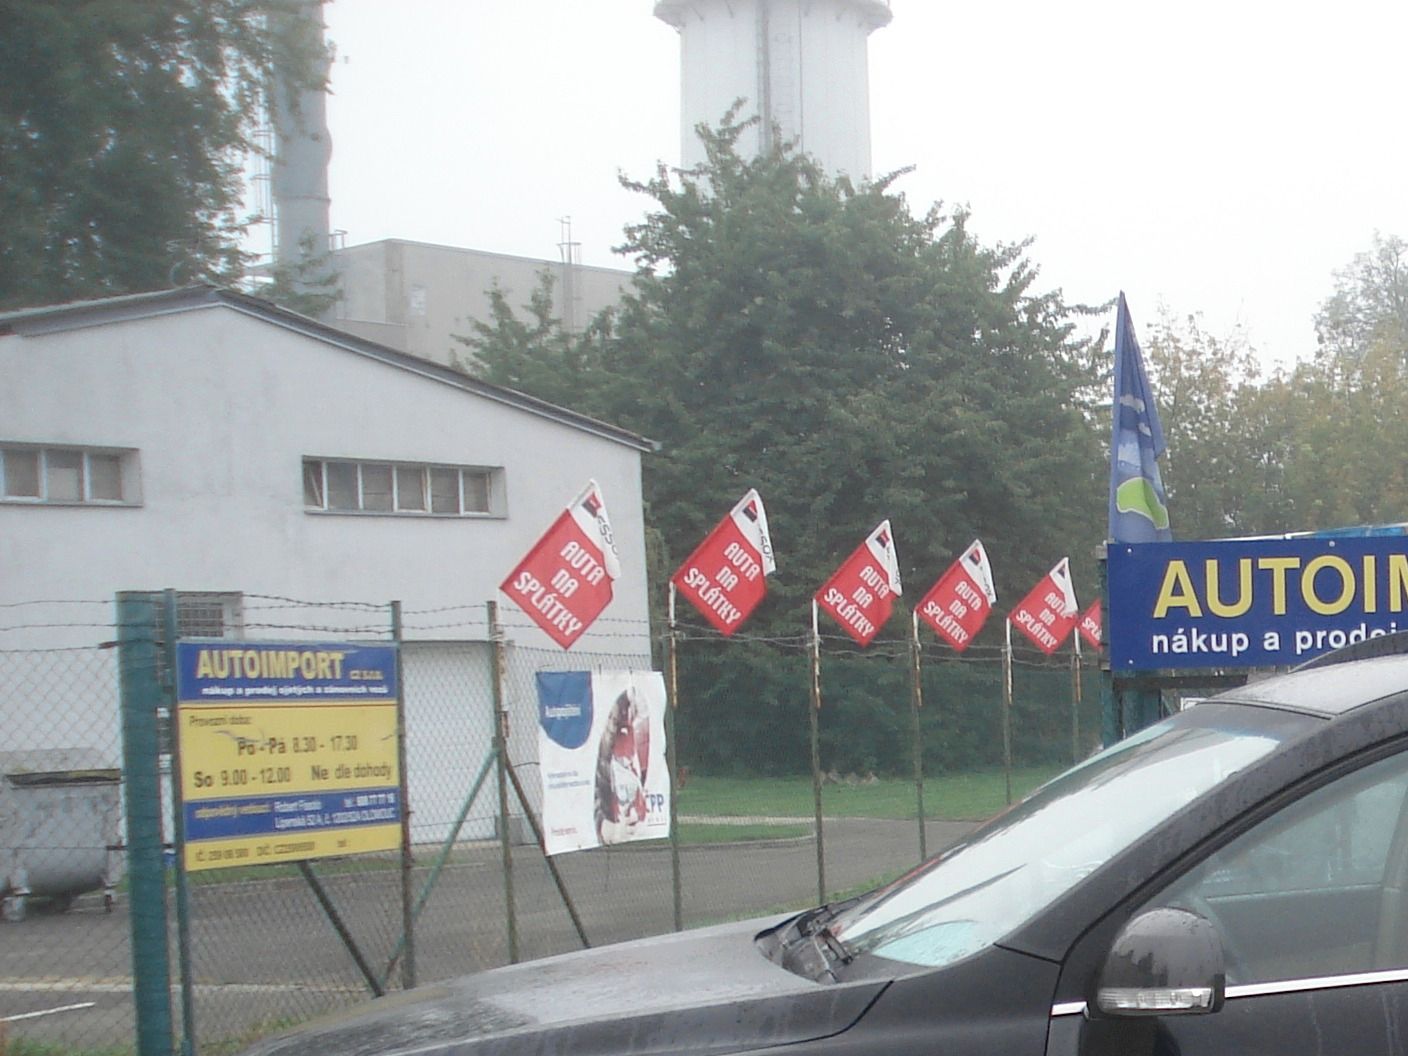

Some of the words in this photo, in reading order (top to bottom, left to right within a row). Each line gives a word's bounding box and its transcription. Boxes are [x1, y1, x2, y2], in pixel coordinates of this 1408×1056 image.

[560, 541, 605, 586] AUTA
[723, 542, 761, 581] AUTA
[551, 569, 580, 599] NA
[715, 566, 739, 592] NA
[859, 565, 890, 599] AUTA
[513, 571, 583, 637] SPLÁTKY
[684, 567, 742, 625] SPLÁTKY
[852, 586, 873, 608] NA
[948, 600, 967, 619] NA
[954, 581, 982, 611] AUTA
[824, 587, 875, 638] SPLÁTKY
[923, 601, 968, 644] SPLÁTKY
[1152, 627, 1250, 657] nákup
[1263, 631, 1281, 651] a
[197, 650, 346, 680] AUTOIMPORT
[194, 771, 214, 788] So
[221, 768, 248, 786] 9.00
[260, 767, 291, 784] 12.00
[311, 764, 329, 781] Ne
[354, 761, 392, 780] dohody
